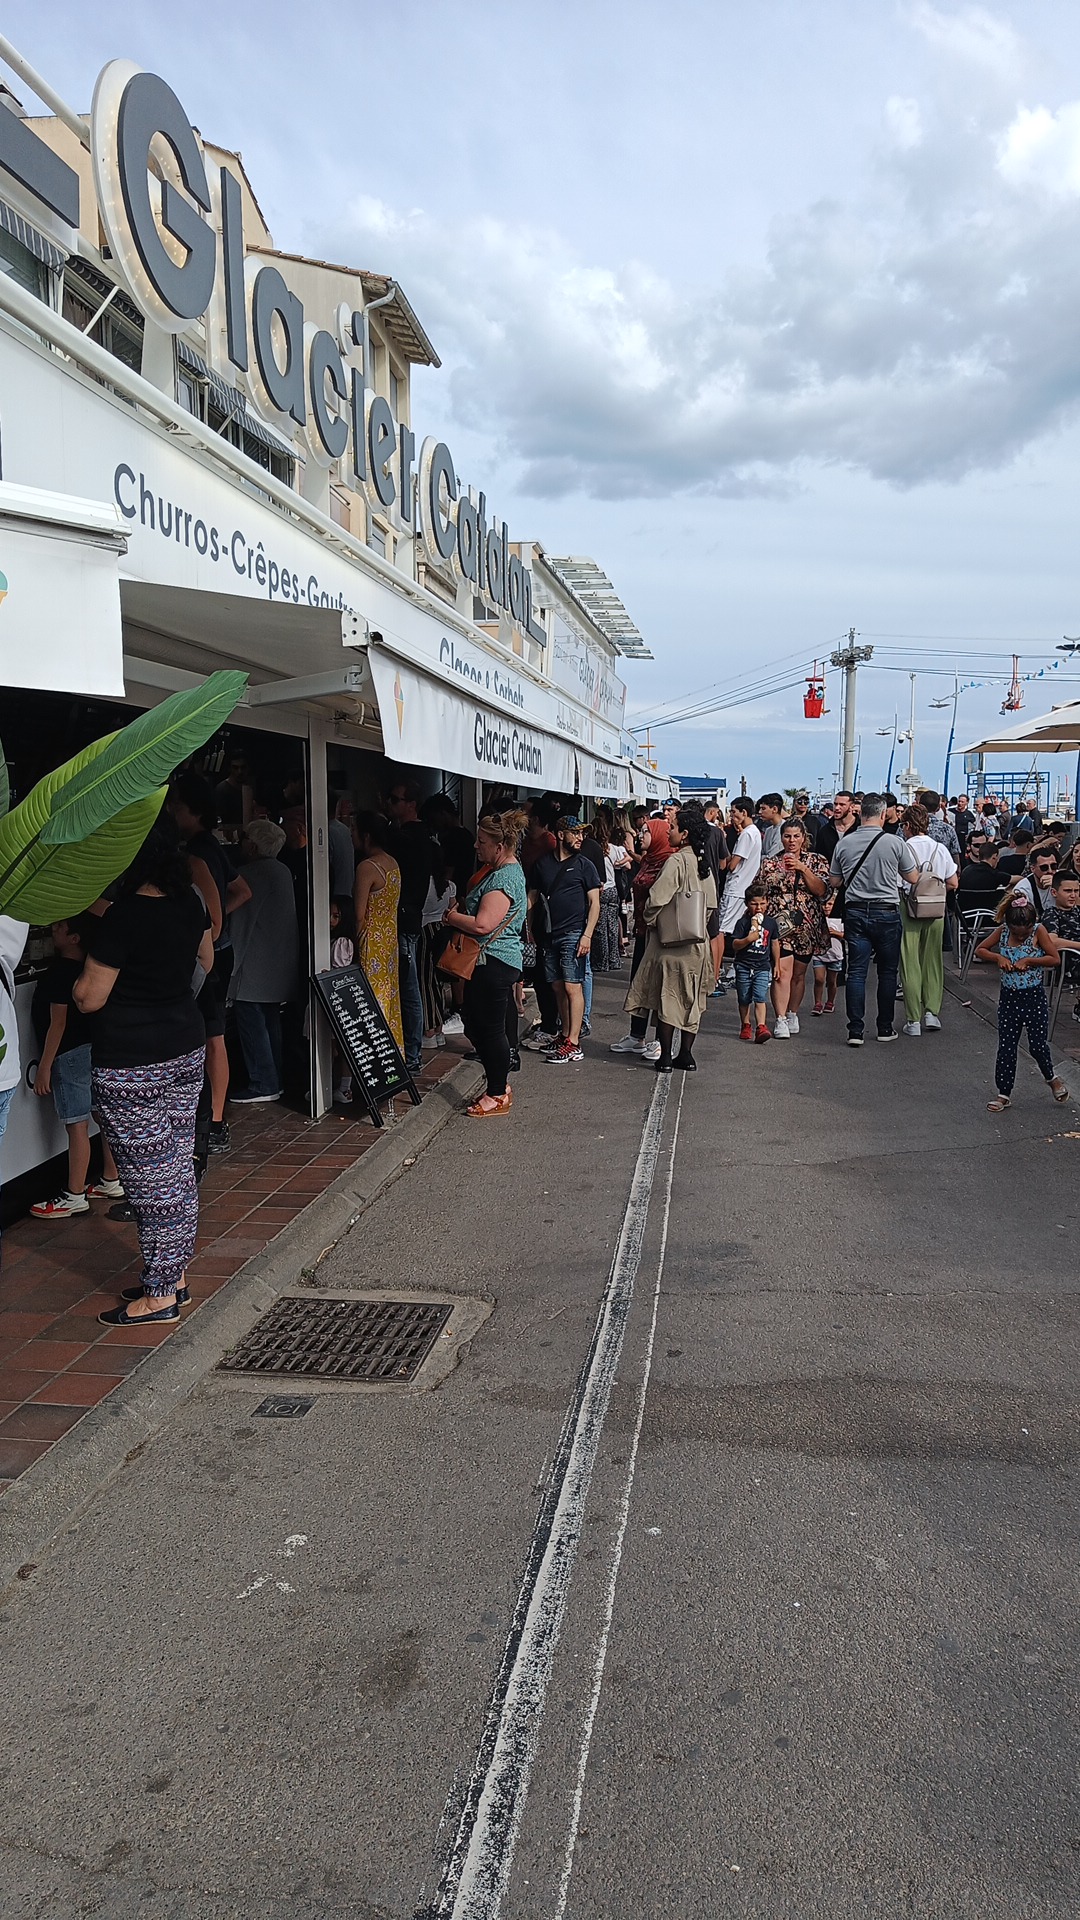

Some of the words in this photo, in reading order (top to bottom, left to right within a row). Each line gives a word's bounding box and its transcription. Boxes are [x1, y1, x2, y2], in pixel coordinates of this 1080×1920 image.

[116, 72, 415, 523] Glacier
[430, 443, 533, 632] Catalan
[474, 712, 510, 767] Glacier
[512, 729, 543, 775] Catalan
